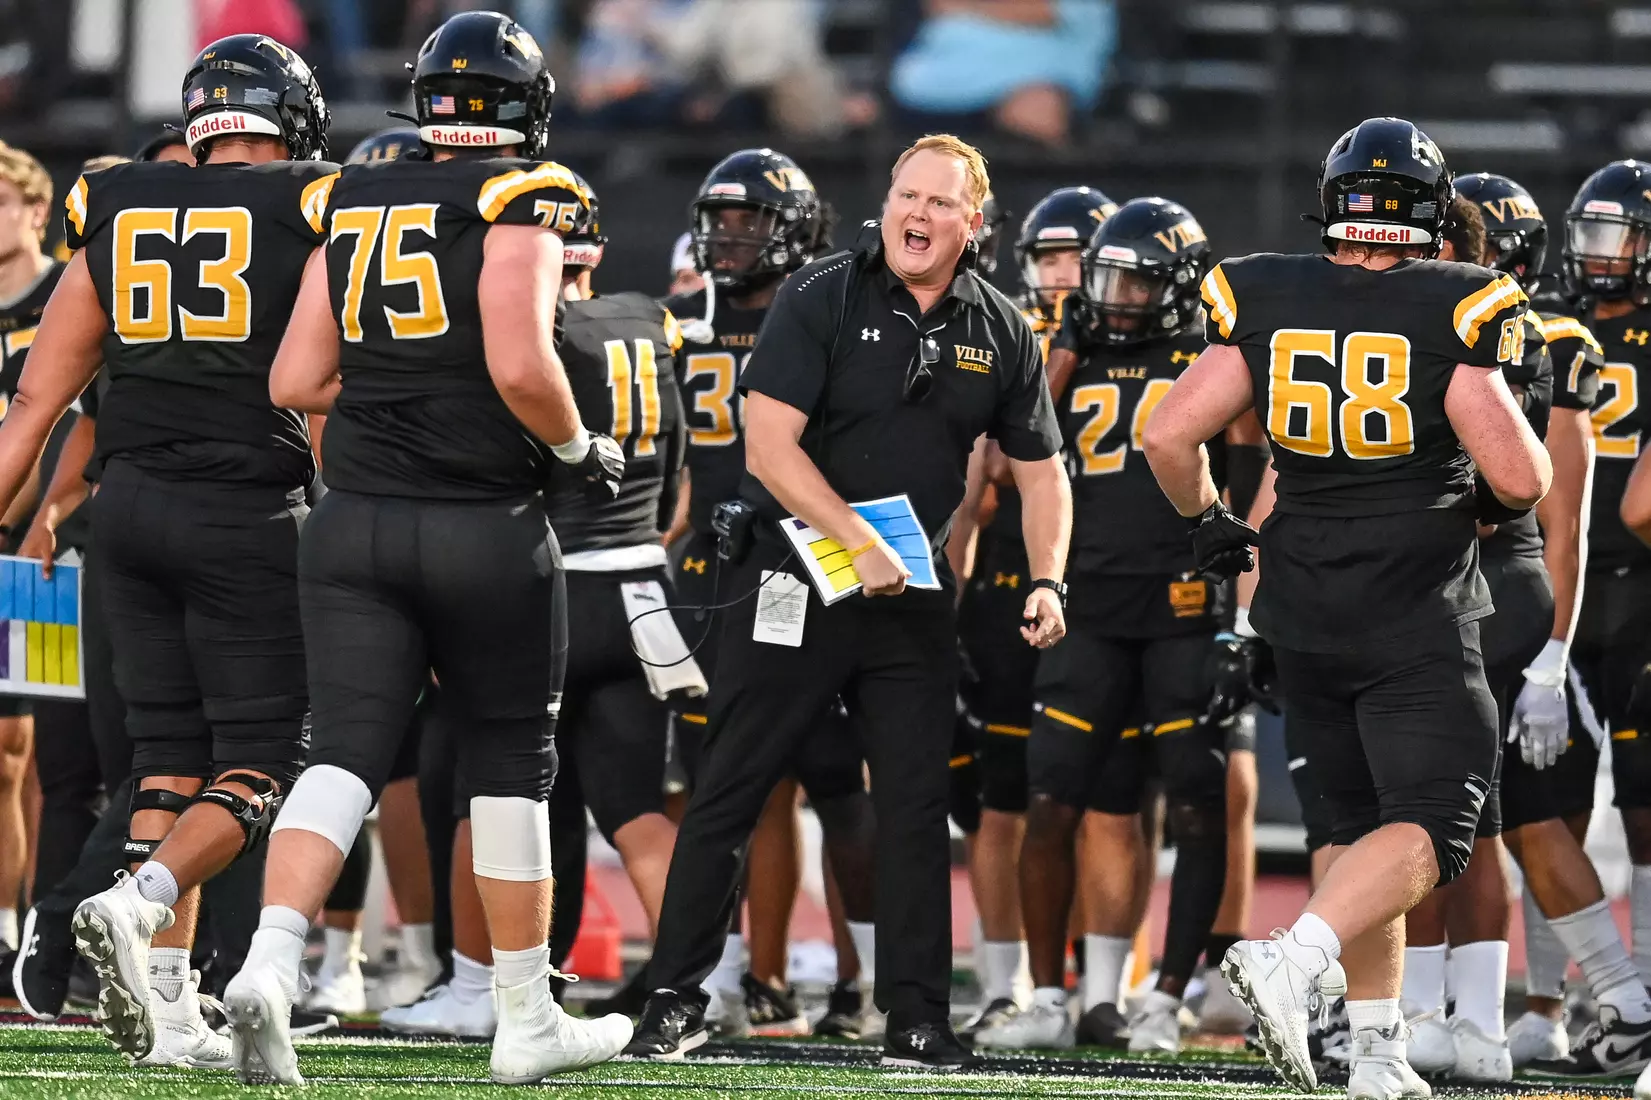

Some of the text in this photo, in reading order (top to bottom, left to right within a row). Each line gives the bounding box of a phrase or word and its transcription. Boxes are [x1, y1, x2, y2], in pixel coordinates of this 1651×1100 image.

[452, 59, 467, 69] MJ
[214, 88, 228, 98] 63
[468, 100, 484, 111] 75
[189, 116, 245, 141] Riddell
[432, 130, 497, 144] Riddell
[1372, 159, 1387, 167] MJ
[1385, 200, 1398, 210] 68
[533, 199, 578, 232] 75
[1345, 226, 1411, 242] Riddell
[113, 206, 253, 344] 63
[330, 203, 450, 342] 75
[953, 344, 993, 367] VILLE
[956, 360, 990, 374] FOOTBALL
[1106, 366, 1148, 379] VILLE
[604, 339, 661, 456] 11
[684, 351, 750, 446] 3
[1267, 328, 1415, 460] 68
[125, 842, 150, 852] BREG
